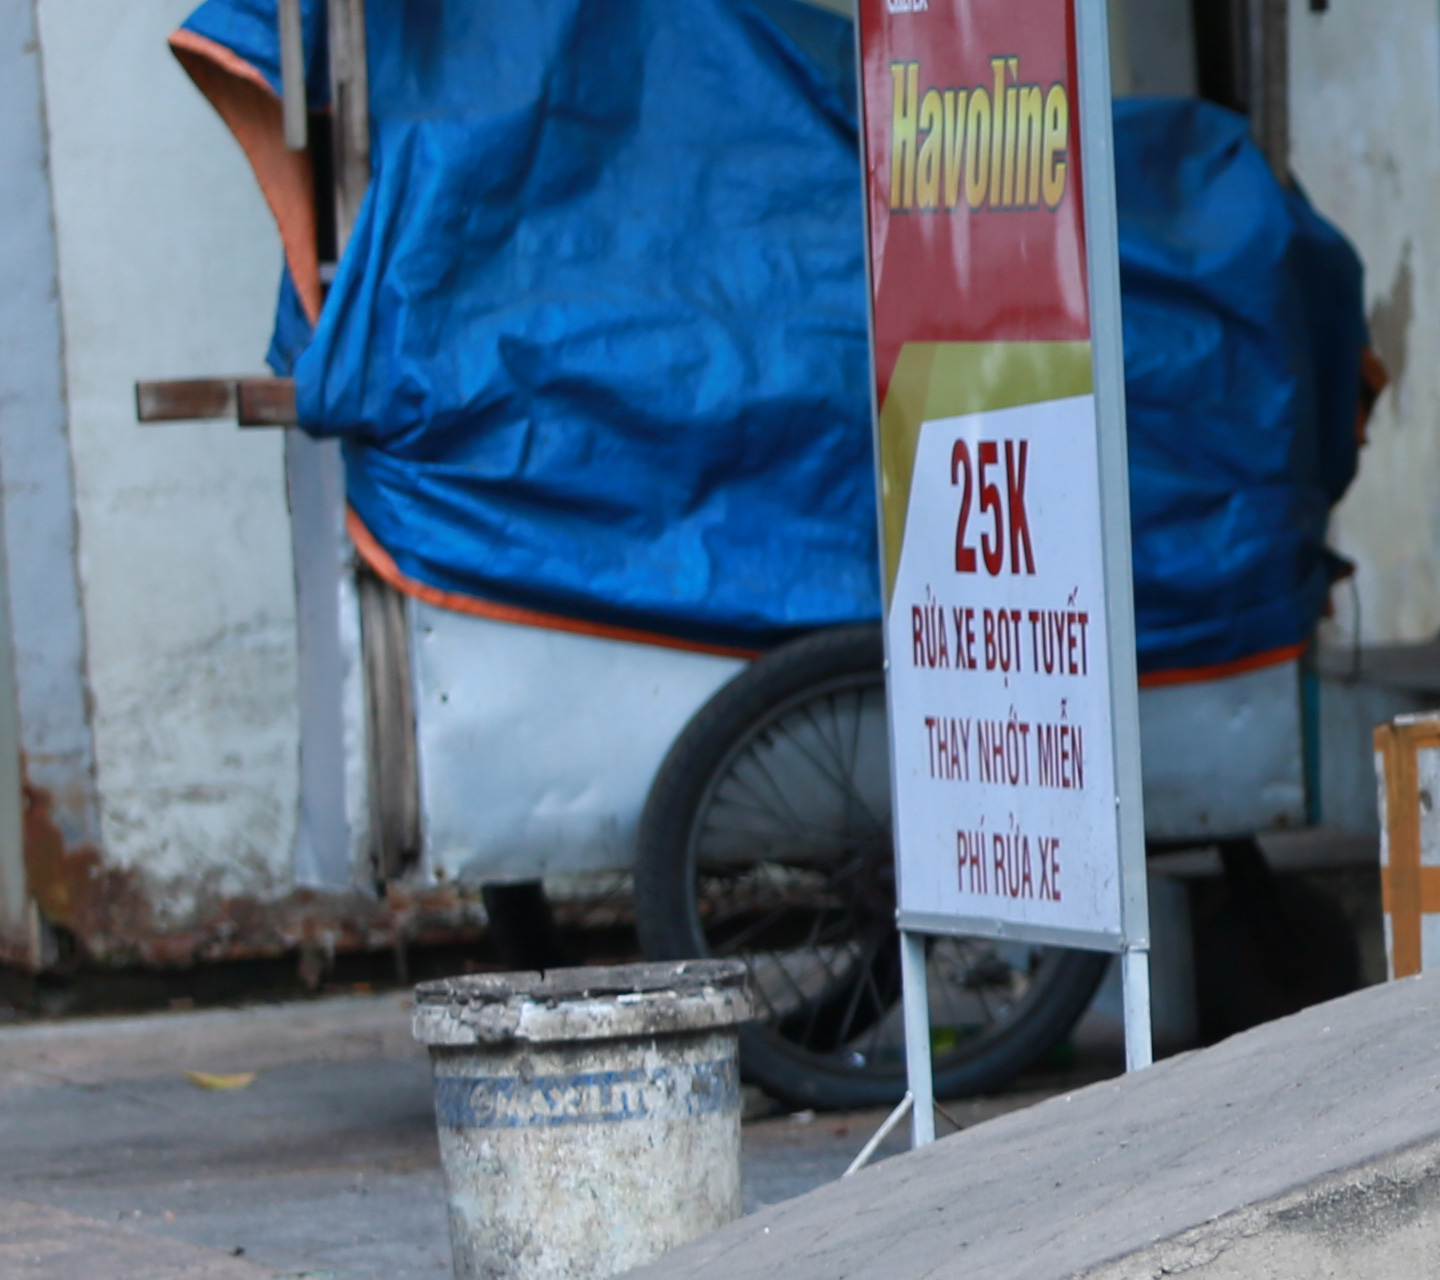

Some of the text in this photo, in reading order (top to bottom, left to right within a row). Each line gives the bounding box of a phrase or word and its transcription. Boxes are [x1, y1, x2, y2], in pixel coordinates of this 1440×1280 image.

[888, 55, 1070, 214] Havoline
[951, 437, 1037, 577] 25K
[911, 583, 1088, 688] RỬA XE BỌT TUYẾT
[925, 715, 971, 782] THAY
[957, 810, 1061, 901] PHÍ RỬA XE
